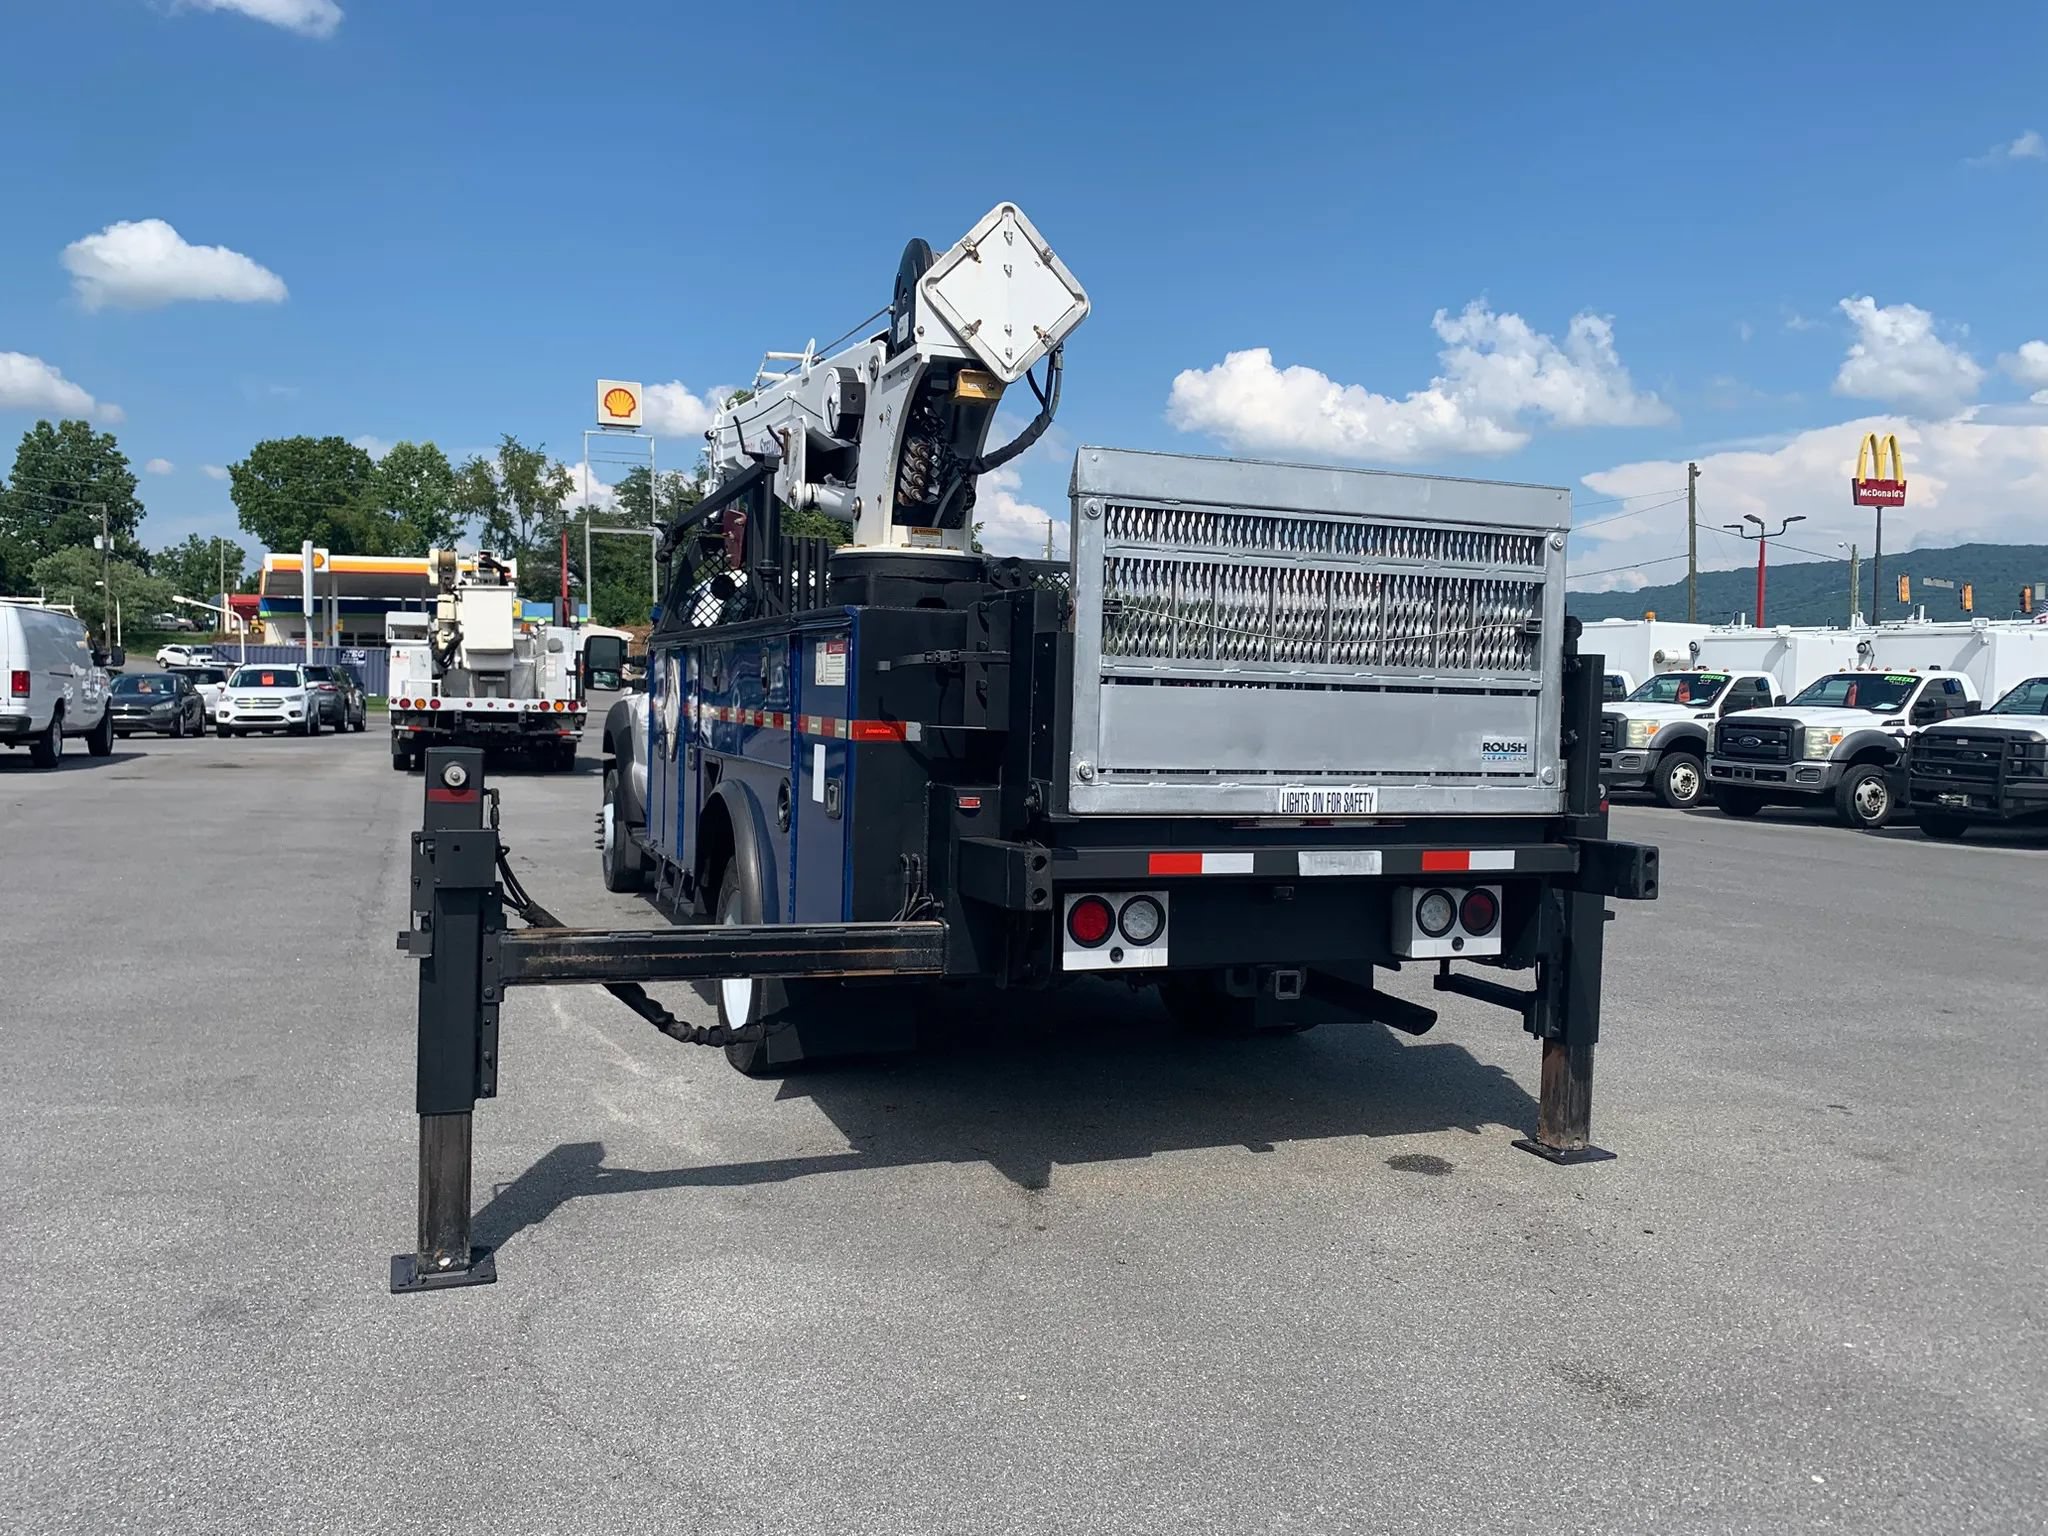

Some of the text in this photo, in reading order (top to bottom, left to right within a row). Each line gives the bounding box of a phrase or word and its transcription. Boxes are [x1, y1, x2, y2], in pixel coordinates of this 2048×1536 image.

[1860, 488, 1904, 498] McDonald's
[1482, 742, 1527, 752] ROUSH
[1282, 792, 1374, 813] LIGHTS ON FOR SAFETY
